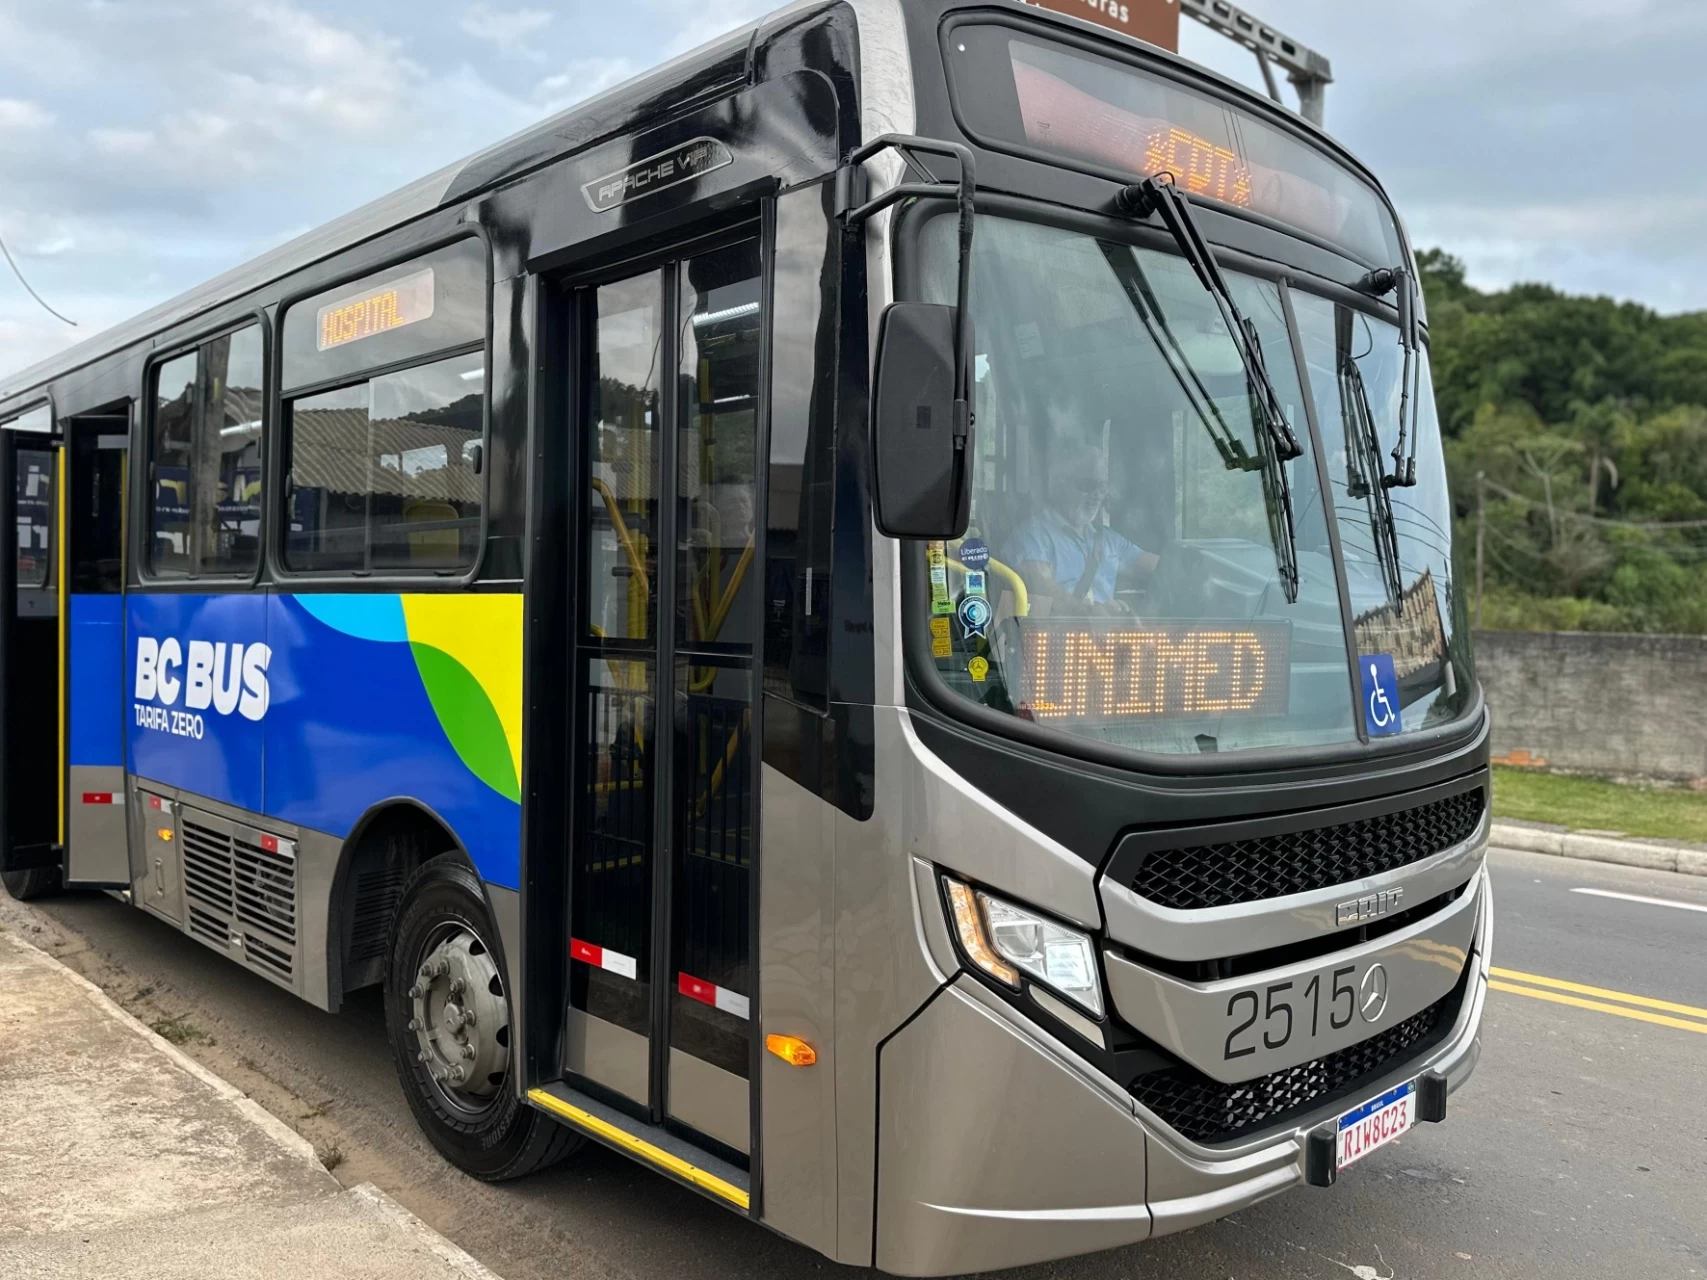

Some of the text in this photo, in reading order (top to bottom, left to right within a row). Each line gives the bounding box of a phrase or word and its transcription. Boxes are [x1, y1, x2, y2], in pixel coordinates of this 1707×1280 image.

[598, 146, 707, 202] APACHE VIP
[322, 291, 403, 346] HOSPITAL
[960, 546, 987, 555] Liberado
[135, 636, 272, 721] BC BUS
[1034, 632, 1264, 717] UNIMED
[134, 704, 204, 740] TARIFA ZERO
[1223, 965, 1355, 1060] 2515
[1344, 1100, 1407, 1160] RIW8C23
